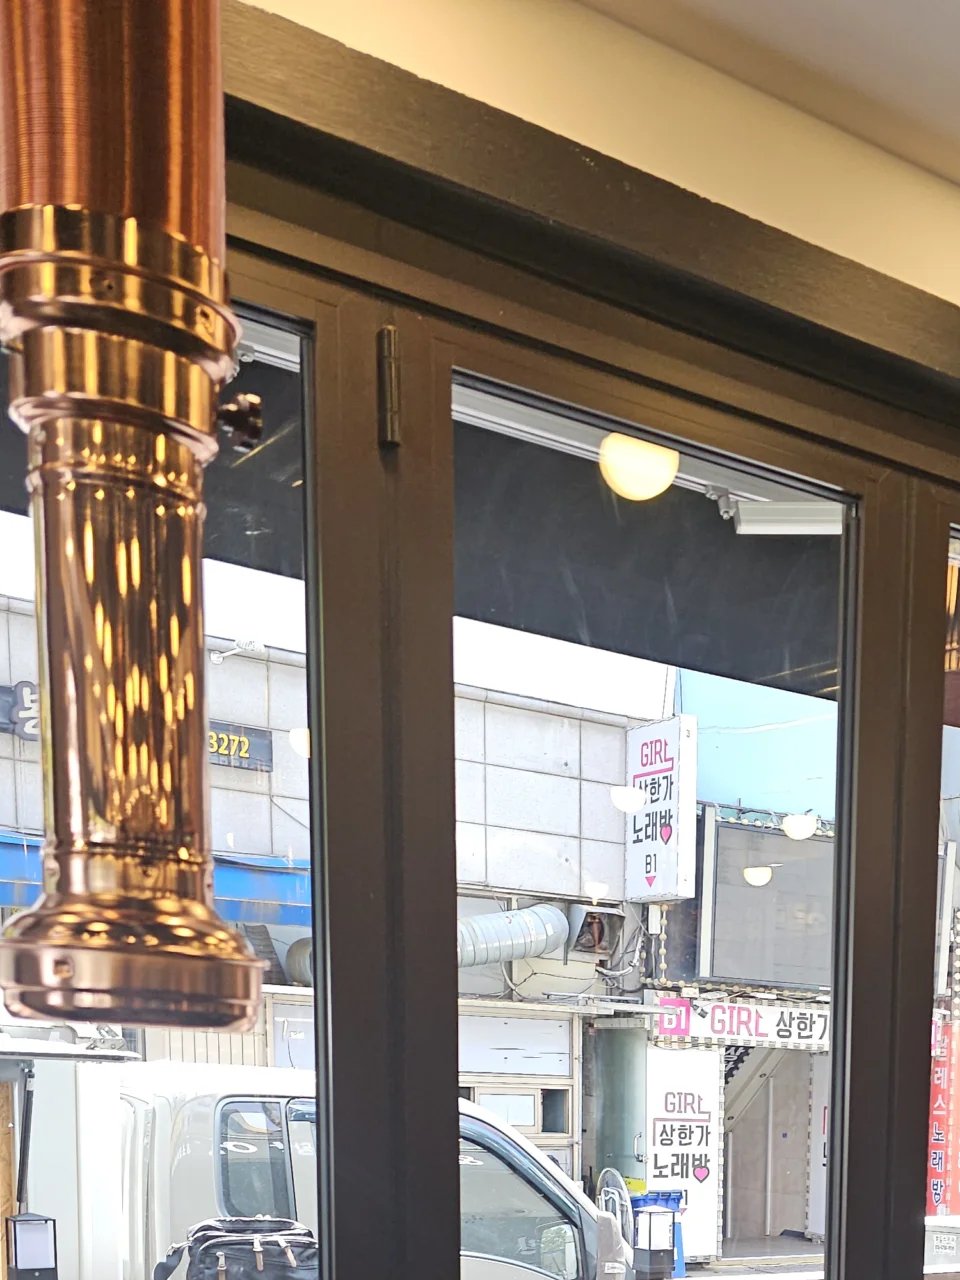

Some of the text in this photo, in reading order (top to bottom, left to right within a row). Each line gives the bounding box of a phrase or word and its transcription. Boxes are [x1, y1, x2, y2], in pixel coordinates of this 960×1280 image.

[208, 731, 250, 758] 3272
[641, 739, 674, 767] GIRL
[632, 809, 674, 845] 노래방
[645, 854, 657, 874] B1
[711, 1005, 768, 1038] GIRL
[664, 1092, 710, 1114] GIRL
[659, 1124, 711, 1147] 상한가
[653, 1153, 710, 1183] 노래방
